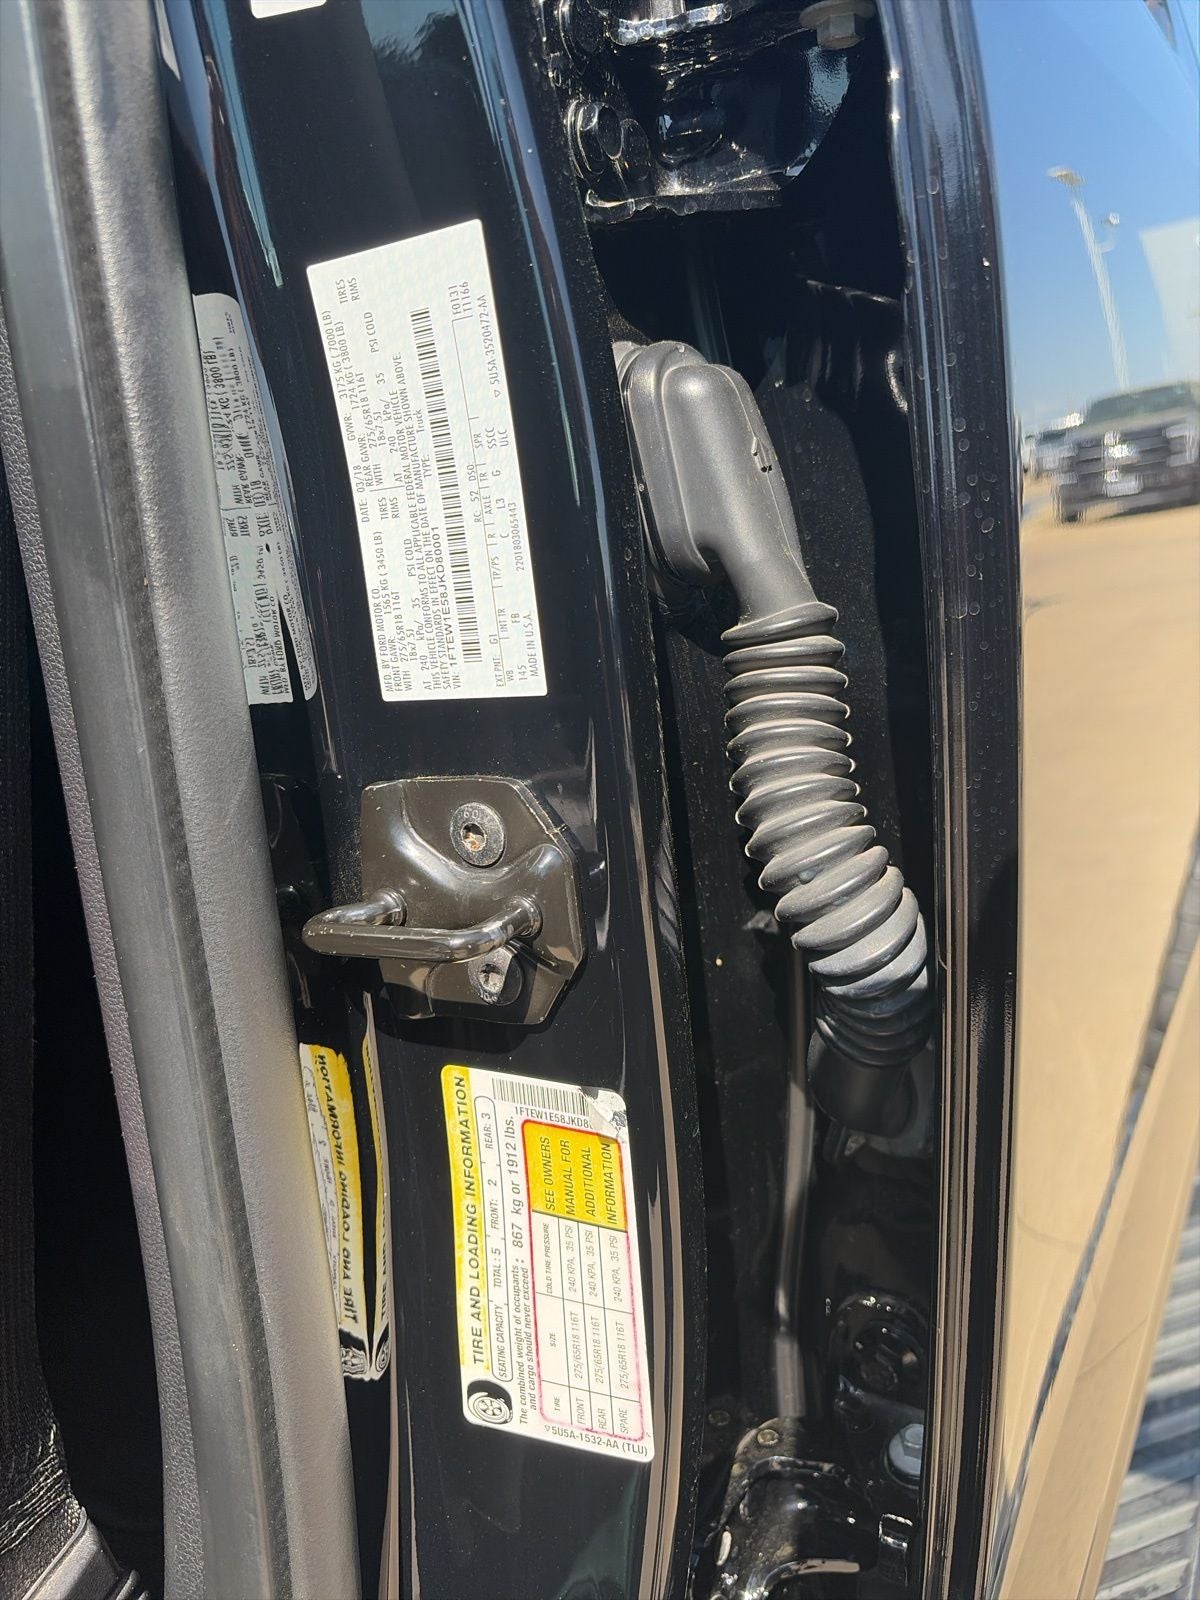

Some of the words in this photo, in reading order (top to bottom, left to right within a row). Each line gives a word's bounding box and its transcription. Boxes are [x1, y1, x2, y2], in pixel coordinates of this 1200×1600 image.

[335, 279, 348, 304] TIRES
[347, 277, 360, 301] RIMS
[321, 310, 332, 326] LB)
[334, 321, 345, 336] LB)
[363, 312, 376, 336] COLD
[325, 328, 337, 352] 7000
[338, 339, 350, 363] 3800
[368, 338, 379, 353] PSI
[332, 361, 342, 373] KG
[344, 372, 354, 384] KG
[375, 372, 385, 385] 35
[392, 352, 406, 384] ABOVE.
[335, 376, 347, 399] 3175
[355, 372, 366, 393] 116T
[348, 387, 360, 410] 1724
[388, 390, 403, 426] VEHICLE
[398, 388, 412, 421] SHOWN
[360, 396, 377, 448] 275/65R18
[413, 408, 425, 433] Truck
[387, 436, 398, 453] 240
[396, 428, 409, 460] MOTOR
[405, 424, 424, 490] MANUFACTURE
[352, 464, 365, 492] 03/18
[362, 464, 373, 487] REAR
[372, 463, 383, 485] WITH
[393, 473, 403, 482] AT
[402, 462, 415, 500] FEDERAL
[358, 498, 370, 522] DATE:
[377, 497, 389, 520] TIRES
[388, 496, 400, 518] RIMS
[416, 493, 425, 504] OF
[482, 495, 493, 515] AXLE
[496, 498, 505, 509] L3
[408, 503, 423, 553] APPLICABLE
[418, 507, 429, 528] DATE
[373, 531, 383, 544] LB)
[403, 538, 414, 560] COLD
[421, 531, 432, 546] THE
[375, 547, 386, 569] 3450
[415, 556, 425, 570] ALL
[424, 550, 434, 562] ON
[406, 564, 416, 576] PSI
[417, 574, 427, 584] TO
[426, 566, 438, 593] EFFECT
[371, 586, 380, 599] CO.
[379, 578, 389, 590] KG
[381, 593, 392, 614] 1565
[390, 591, 401, 610] 116T
[410, 597, 420, 608] 35
[428, 526, 458, 666] 1FTEW1E58JKD80001
[430, 597, 440, 605] IN
[373, 602, 385, 631] MOTOR
[419, 587, 434, 633] CONFORMS
[377, 634, 388, 655] FORD
[393, 614, 409, 662] 275/65R18
[432, 608, 447, 658] STANDARDS
[526, 640, 535, 649] IN
[387, 636, 399, 662] GAWR:
[426, 636, 439, 668] VEHICLE
[381, 659, 390, 668] BY
[419, 655, 430, 670] 240
[517, 664, 528, 680] 145
[527, 653, 539, 676] MADE
[383, 674, 394, 691] MFD.
[391, 666, 403, 691] FRONT
[402, 670, 413, 690] WITH
[422, 680, 432, 690] AT
[430, 672, 442, 689] THIS
[439, 660, 452, 689] SAFETY
[454, 1076, 475, 1196] INFORMATION
[483, 1124, 493, 1149] REAR:
[504, 1116, 515, 1138] lbs.
[505, 1142, 518, 1174] 1912
[540, 1136, 553, 1185] OWNERS
[560, 1140, 571, 1162] FOR
[511, 1181, 520, 1194] or
[563, 1167, 575, 1215] MANUAL
[581, 1147, 596, 1216] ADDITIONAL
[600, 1142, 617, 1224] INFORMATION
[510, 1198, 523, 1215] kg
[545, 1189, 555, 1210] SEE
[489, 1199, 499, 1230] FRONT:
[465, 1203, 480, 1279] LOADING
[511, 1222, 523, 1248] 867
[565, 1240, 573, 1251] 35
[586, 1245, 594, 1256] 35
[610, 1250, 619, 1261] 35
[511, 1265, 521, 1313] occupants
[520, 1266, 530, 1300] exceed
[568, 1276, 576, 1292] 240
[588, 1281, 597, 1296] 240
[613, 1286, 622, 1302] 240
[470, 1286, 482, 1321] AND
[494, 1304, 505, 1343] CAPACITY
[513, 1315, 521, 1324] of
[570, 1311, 579, 1331] 116T
[590, 1315, 600, 1336] 116T
[615, 1321, 625, 1341] 116T
[471, 1326, 484, 1364] TIRE
[514, 1327, 524, 1358] weight
[524, 1331, 533, 1362] should
[496, 1345, 507, 1378] SEATING
[572, 1334, 583, 1378] 275/65R18
[592, 1338, 603, 1383] 275/65R18
[617, 1344, 628, 1389] 275/65R18
[516, 1360, 527, 1405] combined
[528, 1364, 536, 1391] cargo
[528, 1392, 536, 1410] and
[576, 1397, 585, 1424] FRONT
[519, 1408, 528, 1424] The
[597, 1408, 606, 1429] REAR
[618, 1408, 628, 1434] SPARE
[552, 1427, 619, 1449] 5U5A-1532-AA
[622, 1442, 648, 1456] (TLU)
